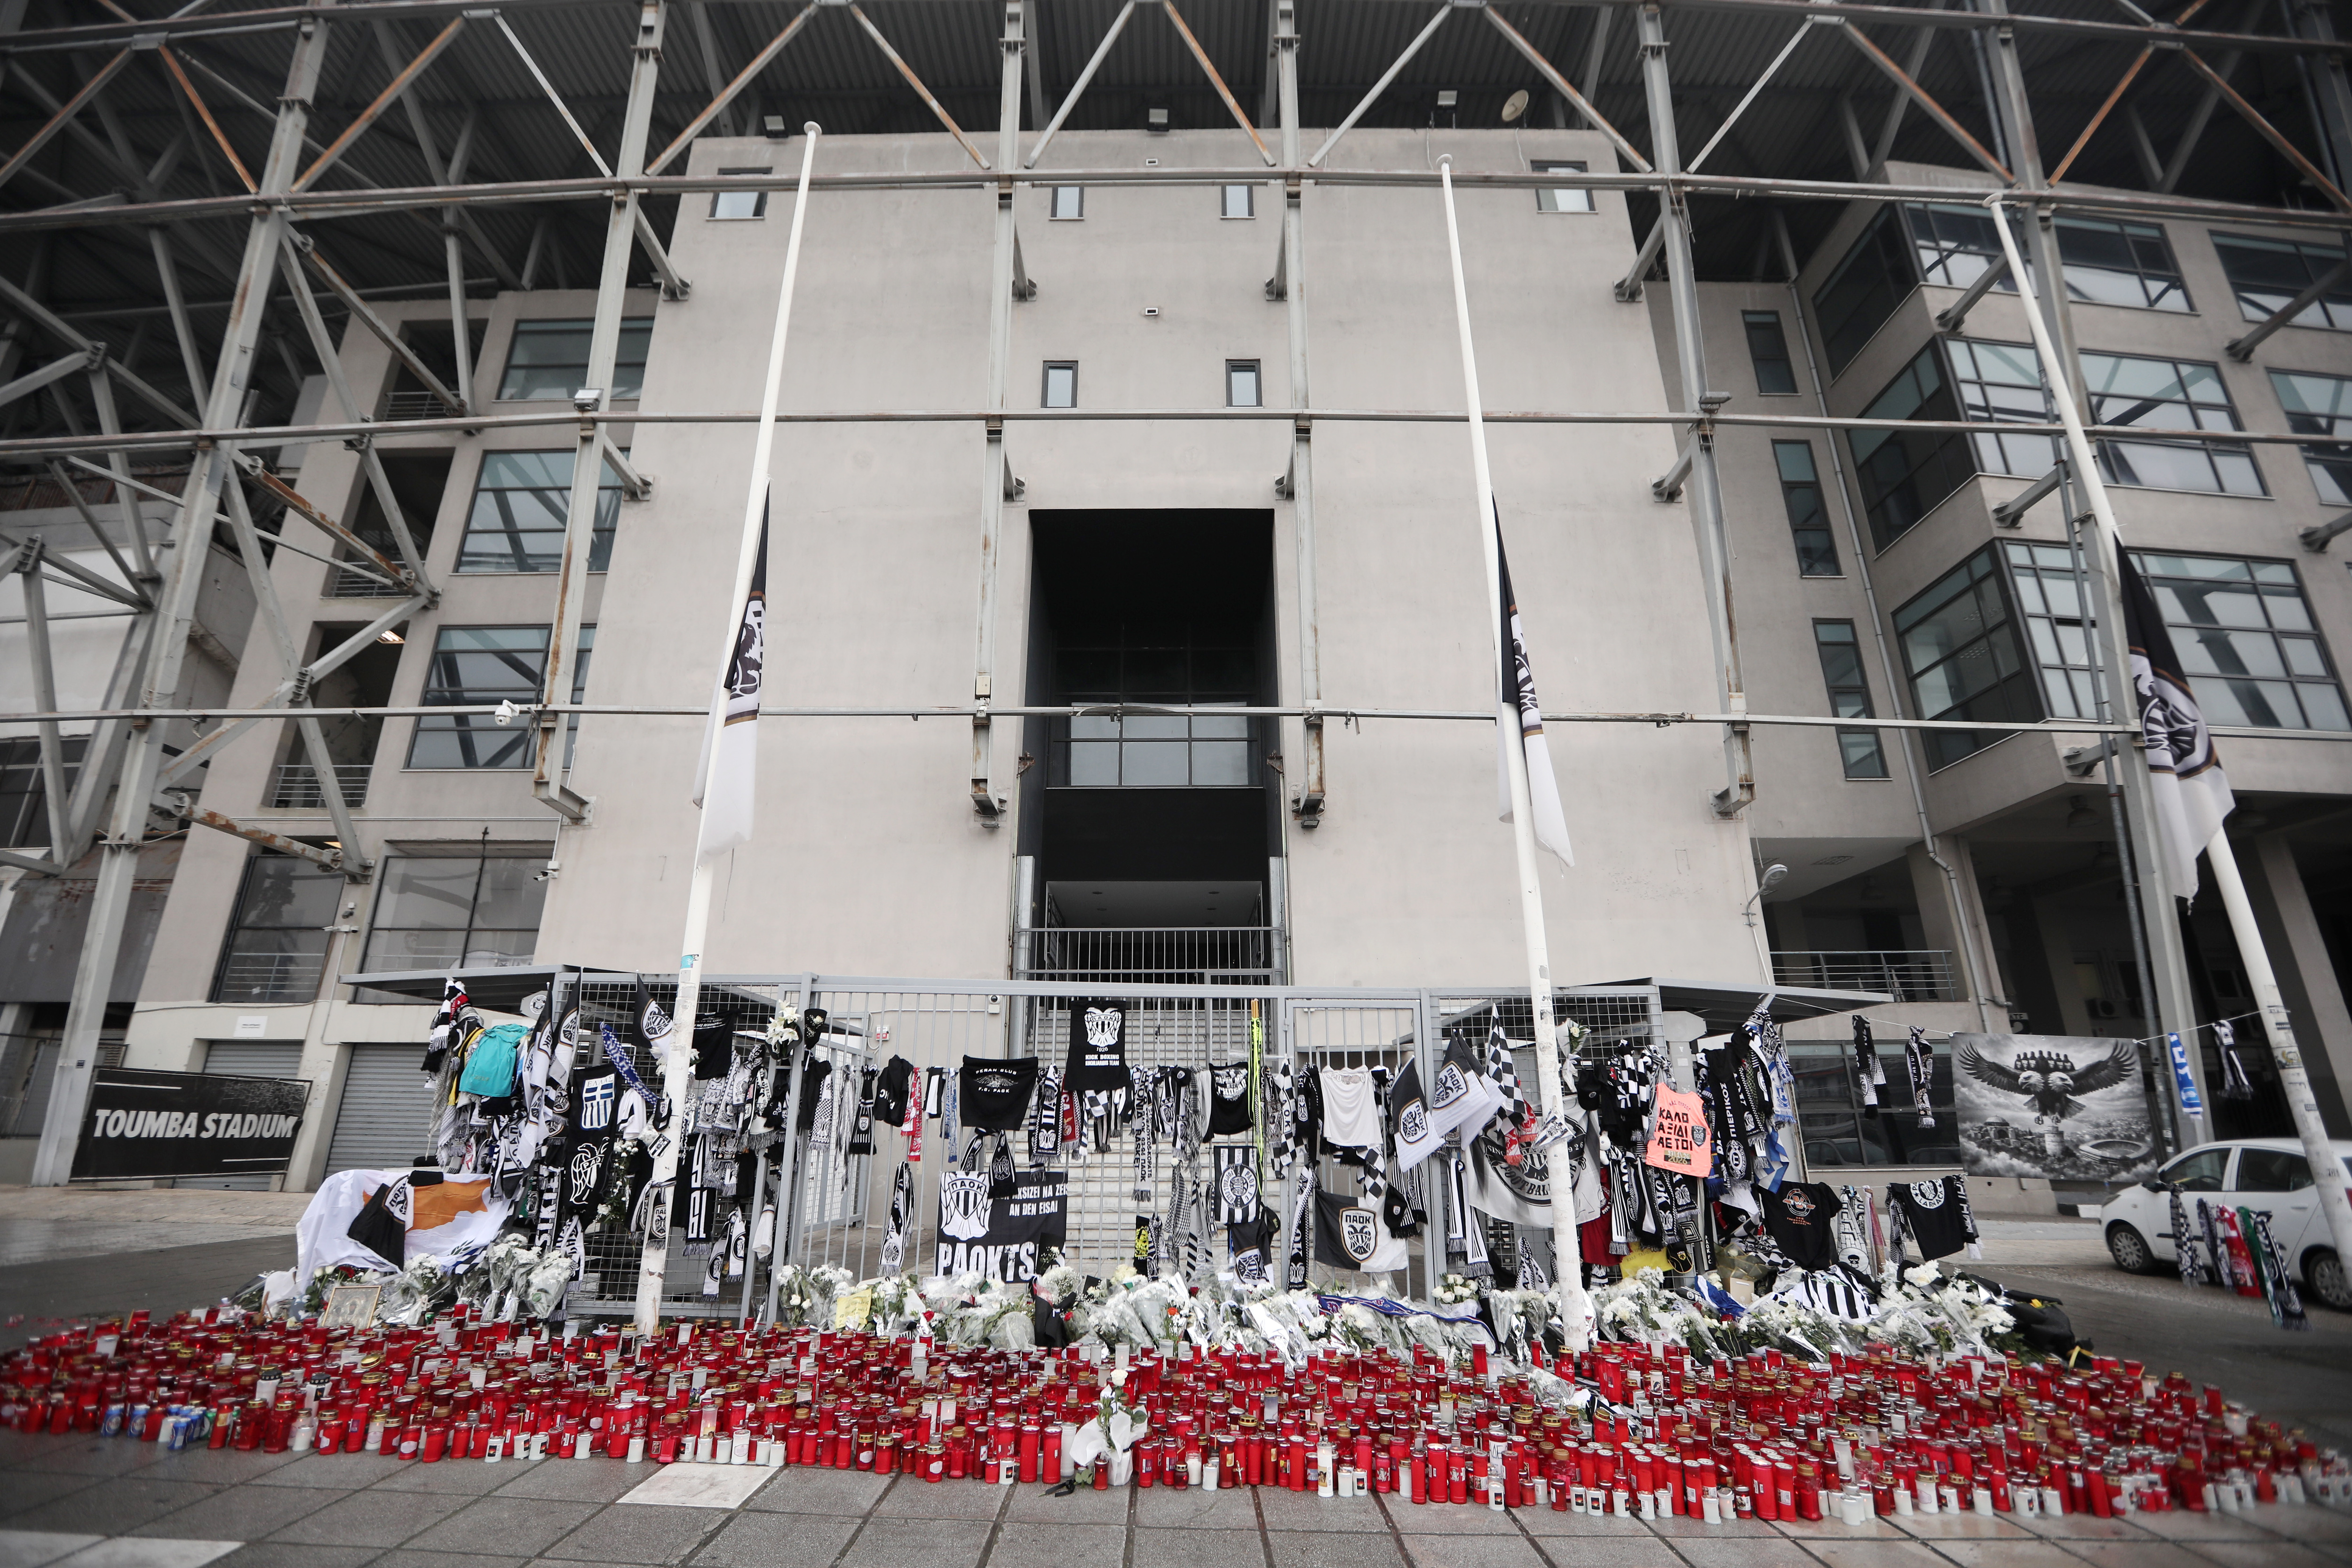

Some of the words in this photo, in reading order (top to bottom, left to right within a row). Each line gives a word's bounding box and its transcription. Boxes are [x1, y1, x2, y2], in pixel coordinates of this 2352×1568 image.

[587, 1075, 613, 1088] ΕΛΛΑΣ
[1659, 1107, 1688, 1123] ΚΑΛΟ
[1722, 1082, 1737, 1138] ΠΙΕΡΙΚΟΣ
[94, 1109, 197, 1138] TOUMBA
[200, 1112, 299, 1139] STADIUM
[1568, 1142, 1584, 1153] 926
[1657, 1136, 1693, 1151] ΑΕΤΟΙ
[1487, 1145, 1505, 1156] SINC
[1668, 1156, 1688, 1165] 2026
[1245, 1169, 1257, 1188] PAOK
[951, 1180, 983, 1191] ΠΑΟΚ
[1042, 1185, 1054, 1197] NA
[1009, 1203, 1020, 1217] AN
[1022, 1202, 1036, 1216] DEN
[1039, 1200, 1058, 1215] EISAI
[1345, 1215, 1371, 1224] ΠΑΟΚ
[1707, 1254, 1712, 1264] FC
